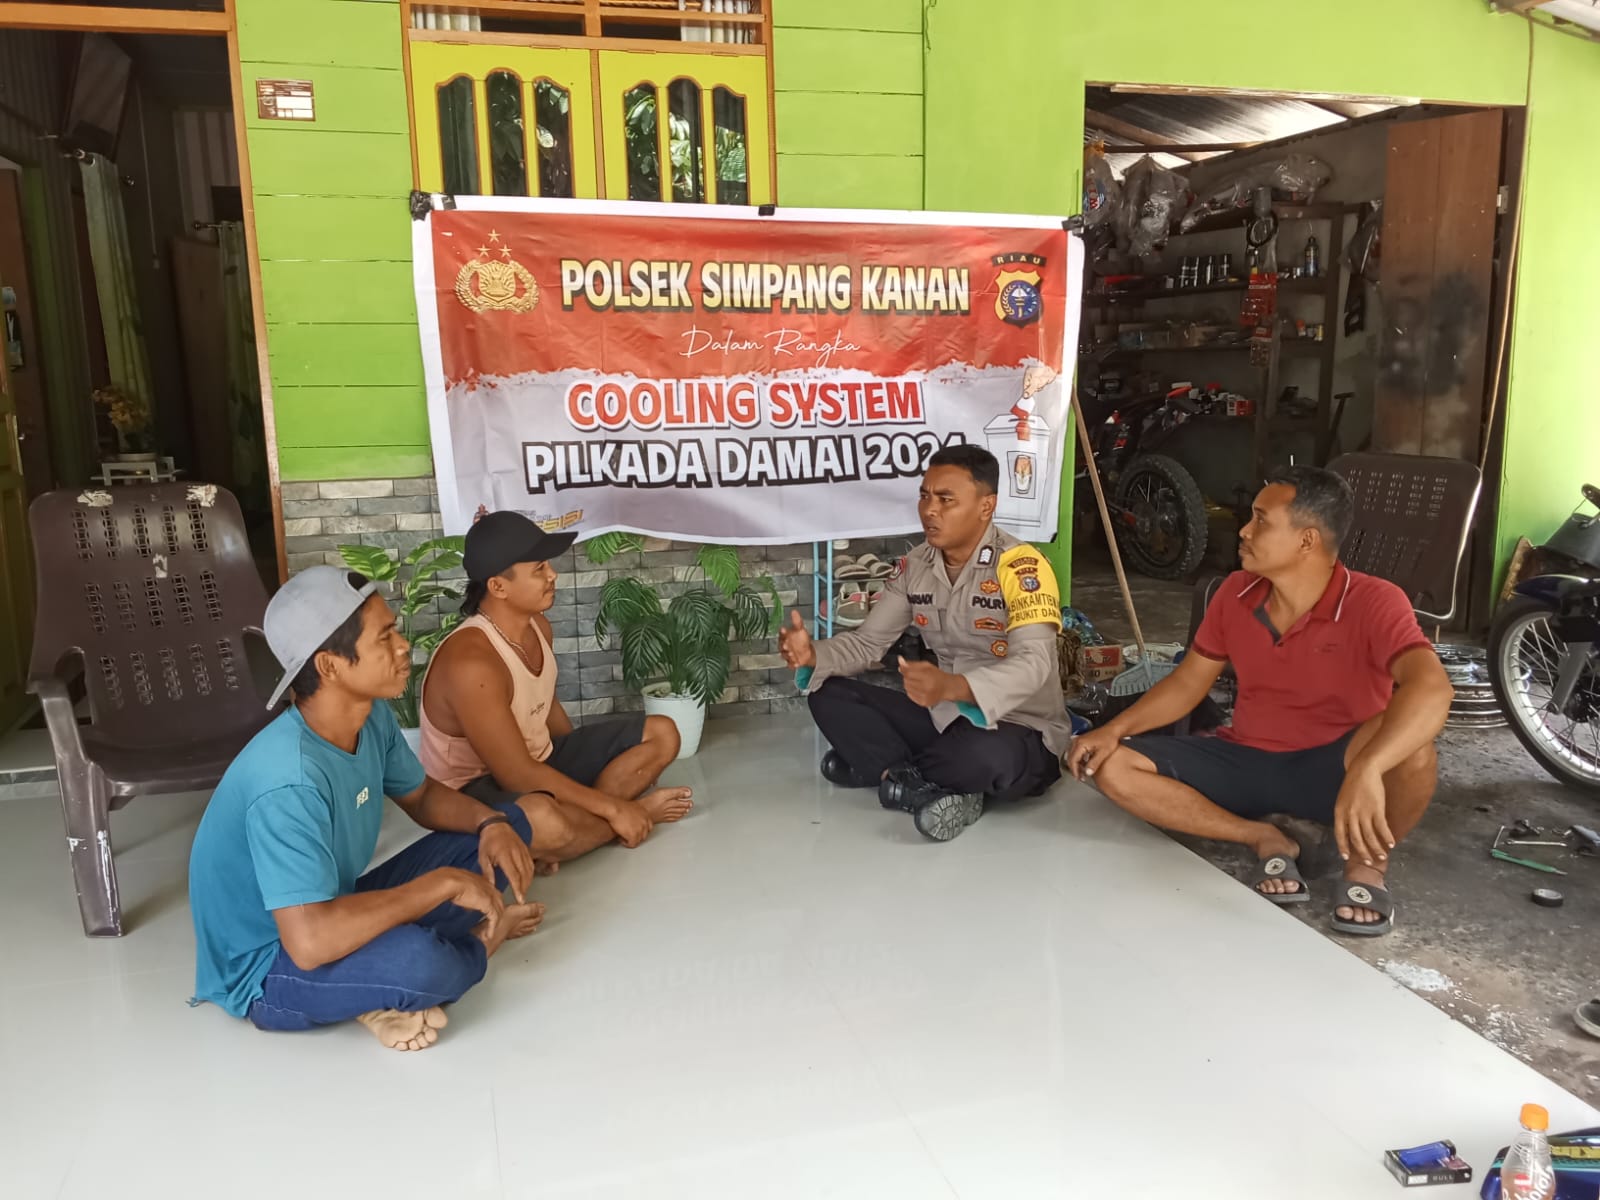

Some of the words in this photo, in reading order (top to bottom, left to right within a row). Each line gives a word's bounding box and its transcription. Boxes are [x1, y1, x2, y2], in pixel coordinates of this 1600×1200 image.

[997, 255, 1040, 265] RIAU
[560, 259, 693, 311] POLSEK
[700, 261, 852, 314] SIMPANG
[861, 265, 971, 315] KANAN
[679, 324, 763, 358] Dalam
[765, 327, 861, 367] Rangka
[566, 378, 760, 430] COOLING
[768, 378, 926, 428] SYSTEM
[522, 438, 712, 494] PILKADA
[715, 433, 860, 487] DAMAI
[972, 596, 1006, 610] POLRI
[1015, 608, 1038, 622] BUKIT
